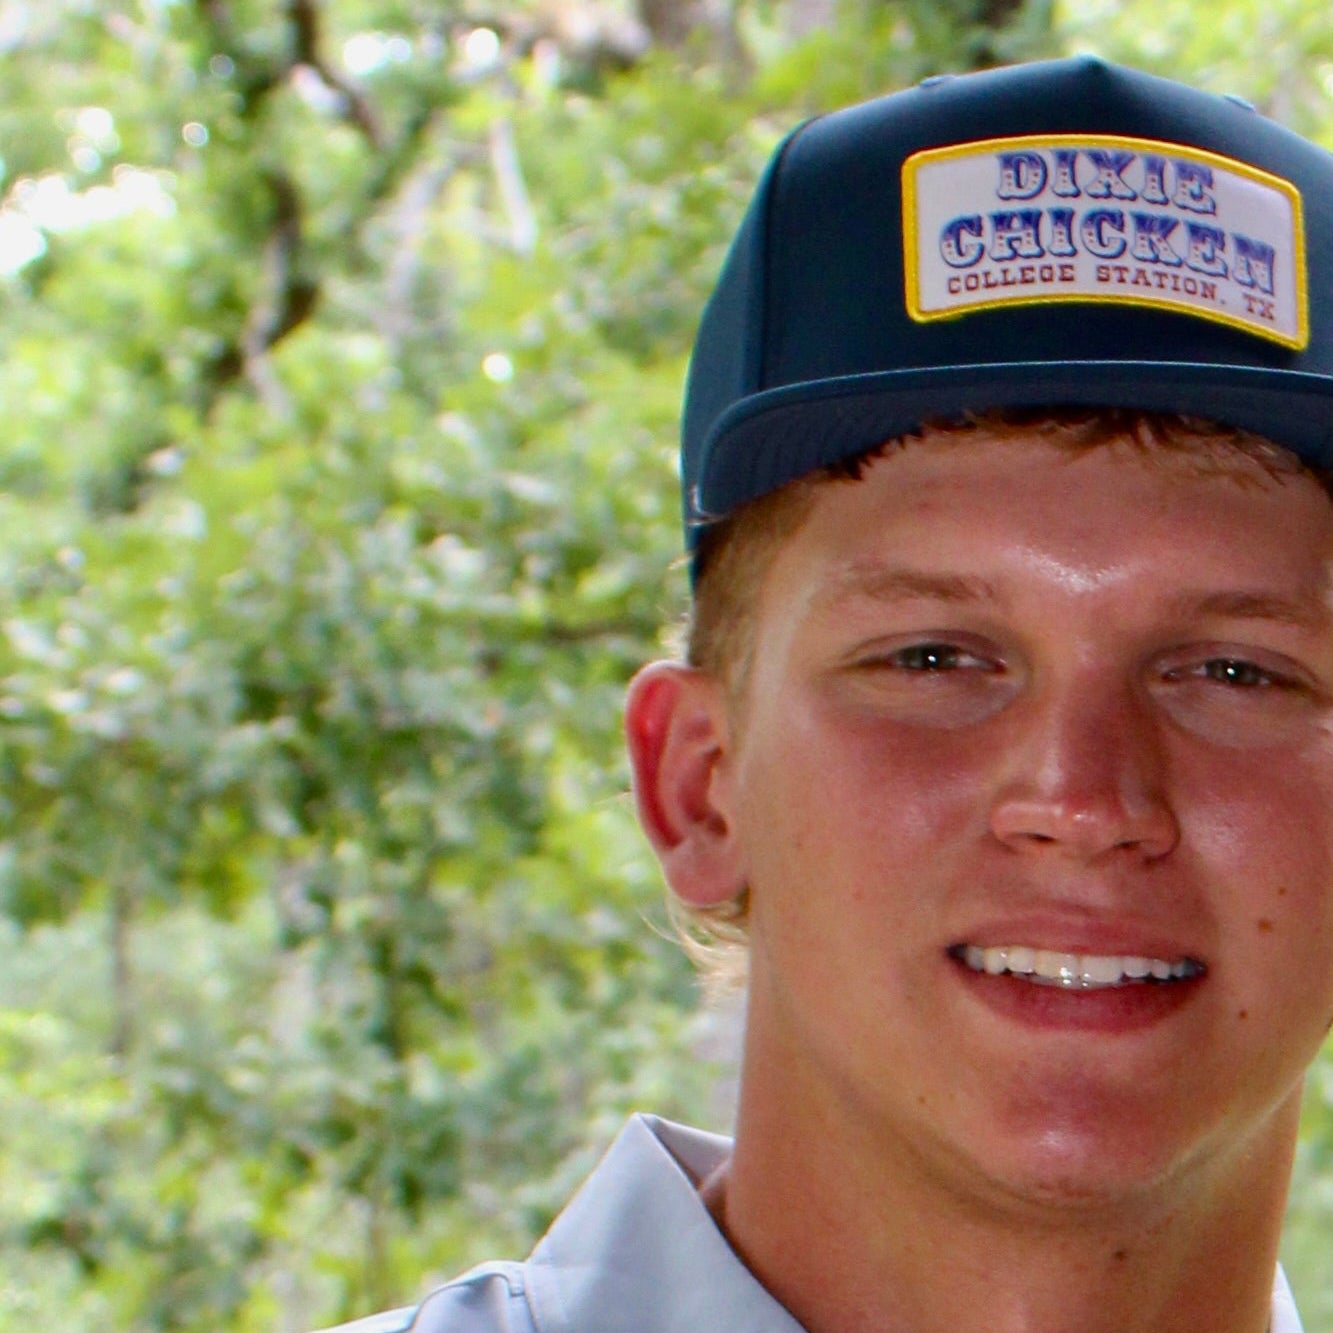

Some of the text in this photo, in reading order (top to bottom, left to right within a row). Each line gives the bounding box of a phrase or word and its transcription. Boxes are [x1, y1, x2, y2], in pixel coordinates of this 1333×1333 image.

[997, 148, 1217, 216] DIXIE
[939, 206, 1276, 297] CHICKEN
[947, 264, 1076, 296] COLLEGE
[1242, 293, 1277, 322] TX
